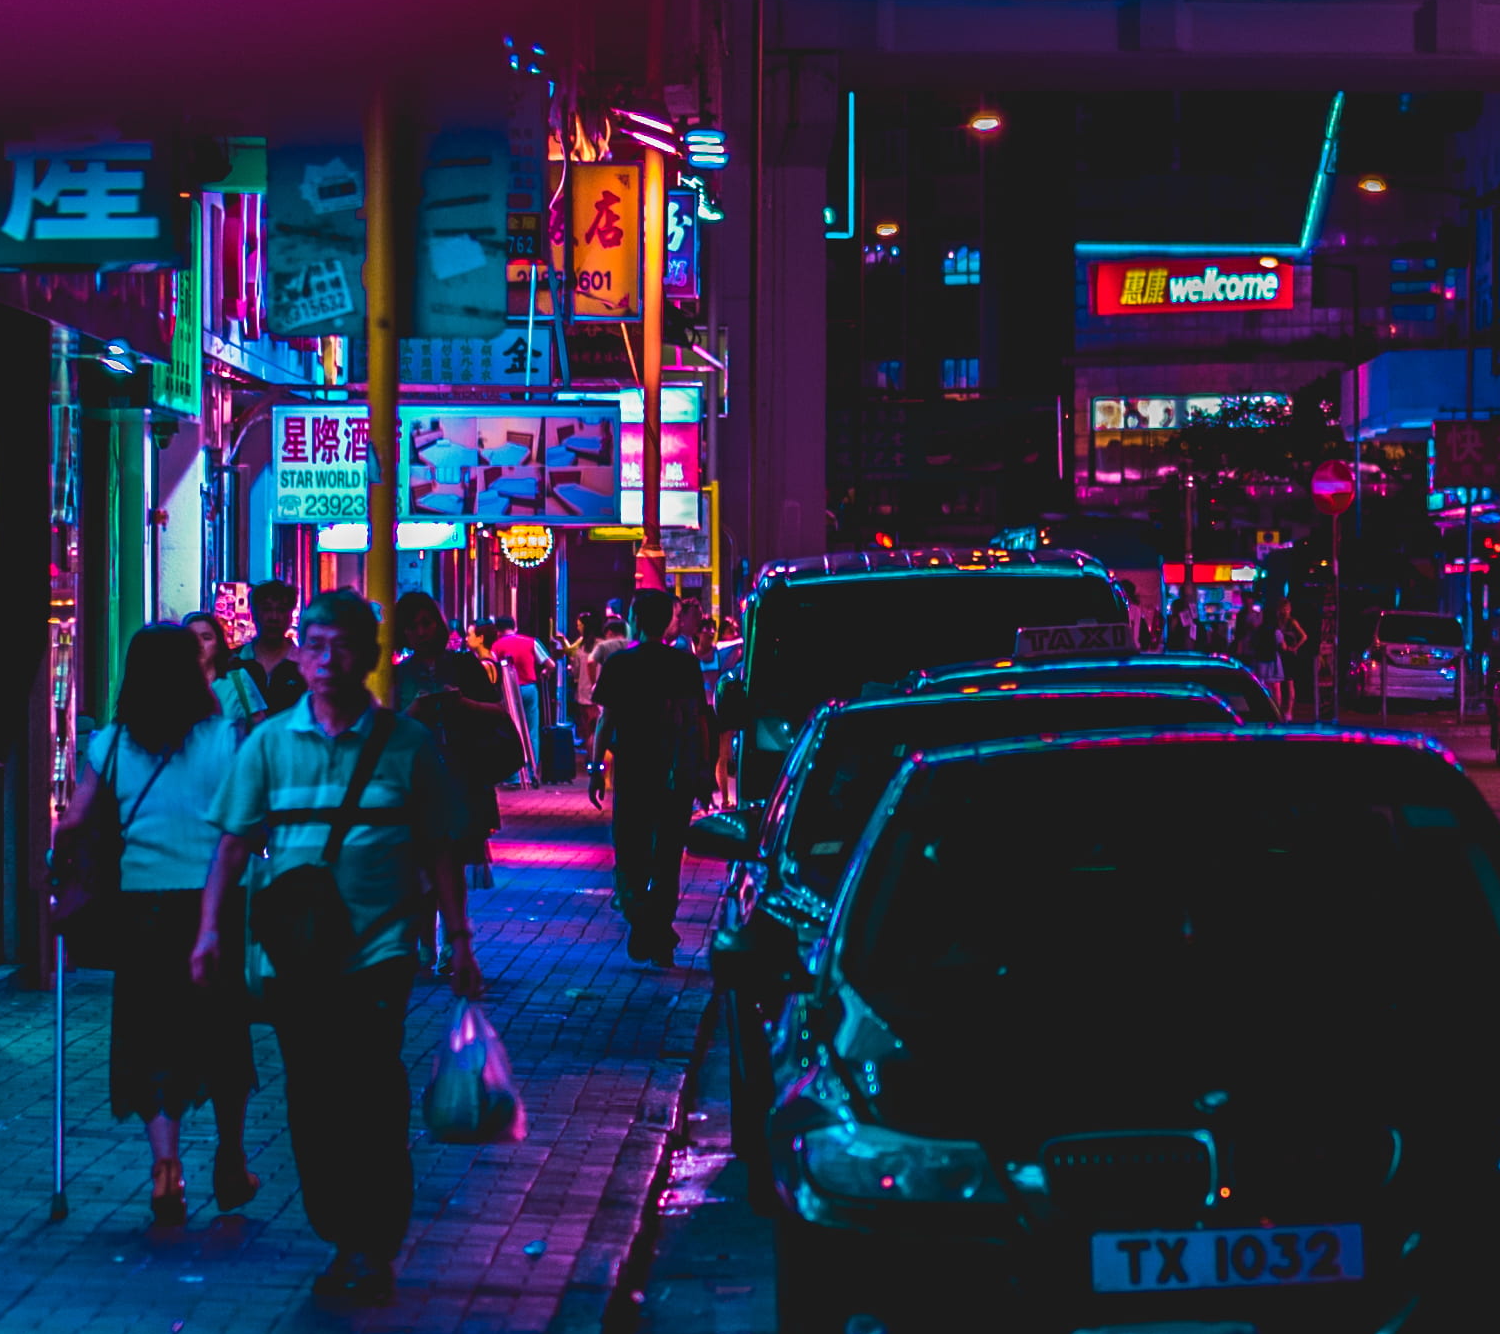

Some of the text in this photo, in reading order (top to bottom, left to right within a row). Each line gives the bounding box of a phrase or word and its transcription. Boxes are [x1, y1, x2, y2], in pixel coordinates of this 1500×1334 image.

[1169, 266, 1279, 303] wellcome
[281, 416, 403, 465] 星際酒
[280, 469, 314, 489] STAR
[315, 469, 362, 489] WORLD
[304, 492, 404, 517] 239238
[1027, 626, 1127, 652] TAXI
[1117, 1230, 1343, 1284] TX 1032
